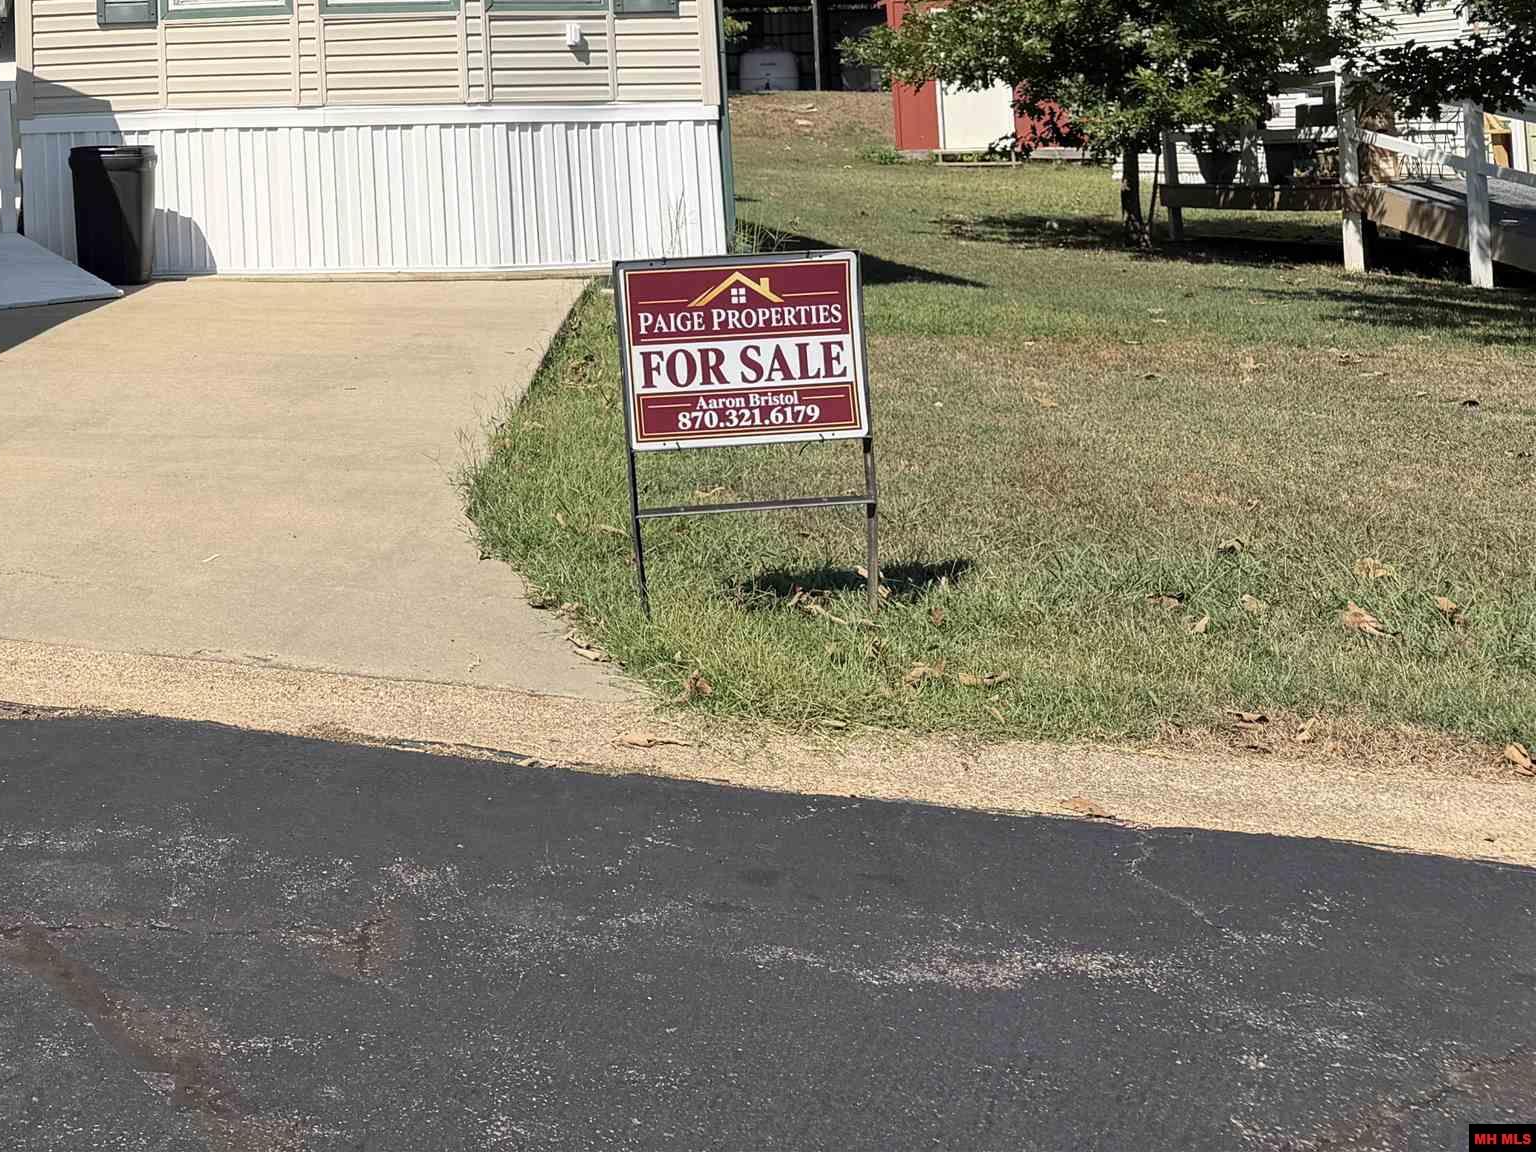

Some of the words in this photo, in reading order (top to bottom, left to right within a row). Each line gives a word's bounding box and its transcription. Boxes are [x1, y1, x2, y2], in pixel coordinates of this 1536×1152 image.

[640, 348, 730, 389] FOR
[739, 341, 847, 384] SALE
[696, 395, 745, 410] Aaron
[749, 391, 799, 406] Bristol
[677, 405, 820, 430] 870.321.6179
